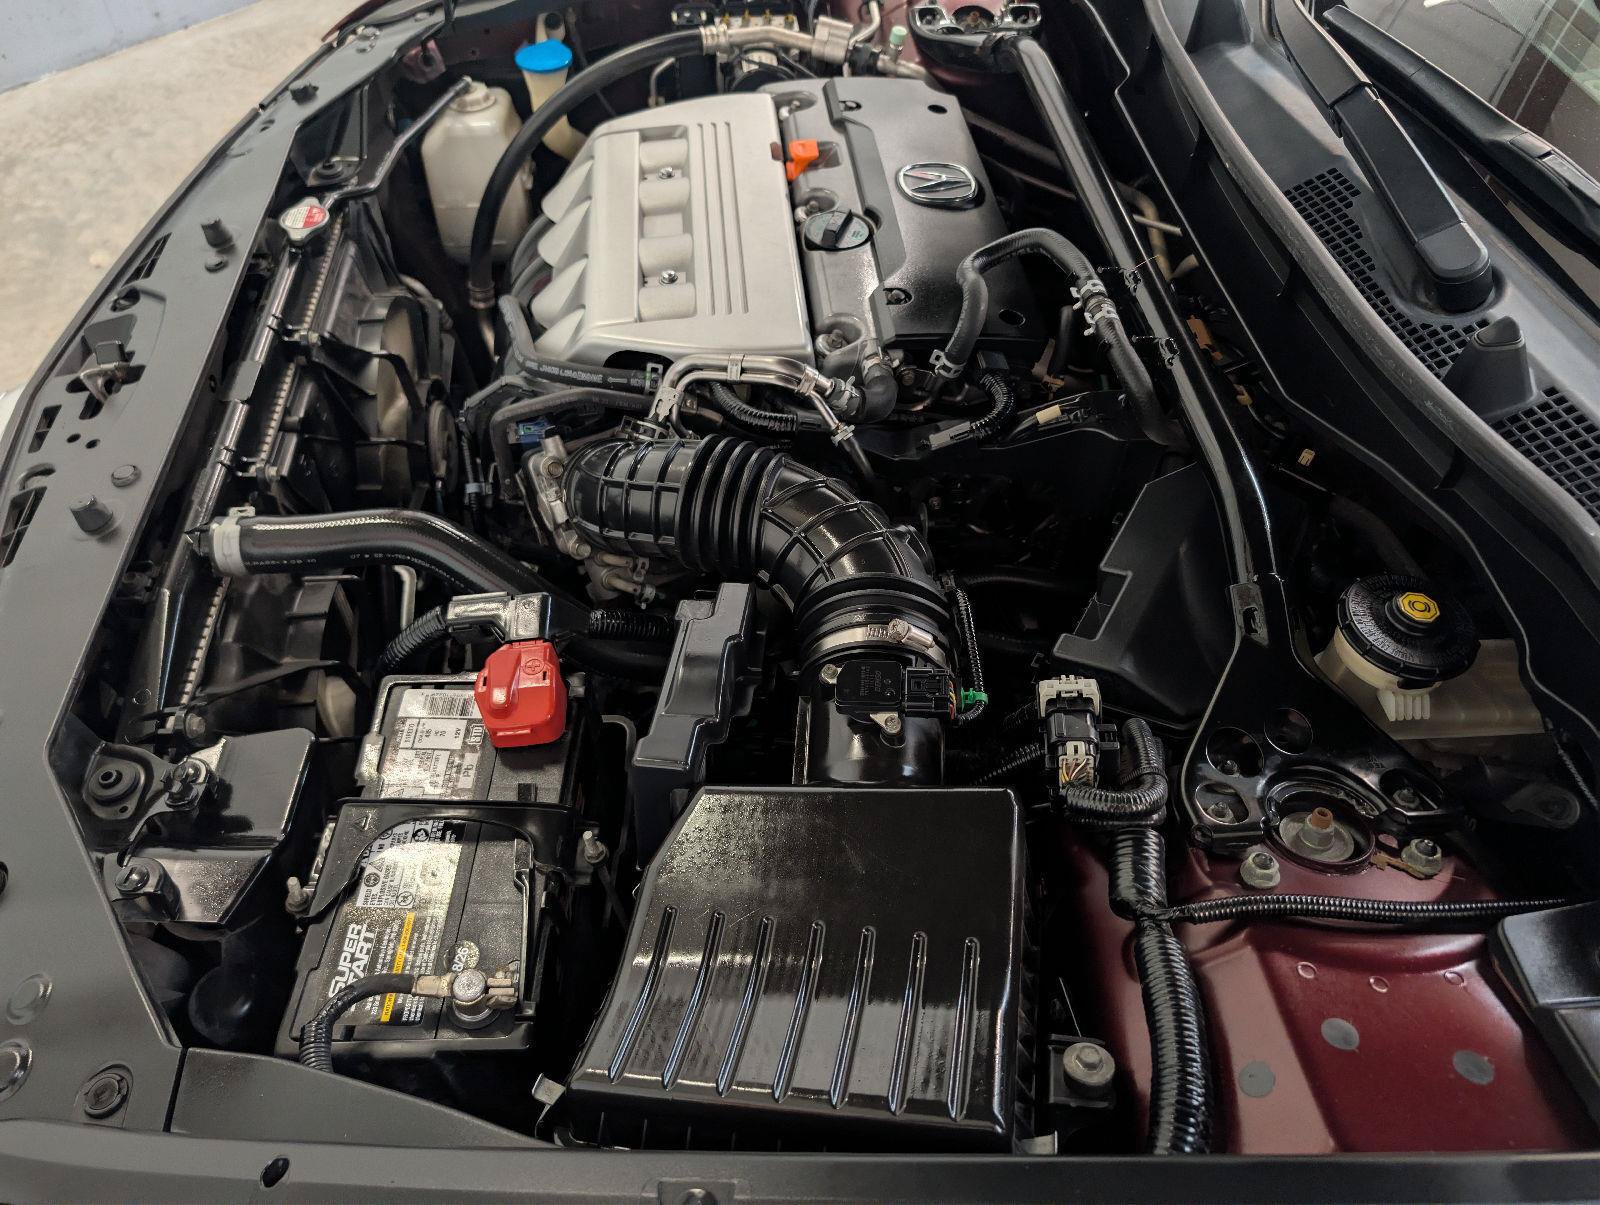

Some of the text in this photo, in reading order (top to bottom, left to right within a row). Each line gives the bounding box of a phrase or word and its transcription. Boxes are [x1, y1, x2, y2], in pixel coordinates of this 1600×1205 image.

[463, 764, 474, 777] Pb
[328, 923, 361, 998] SUPER
[344, 920, 377, 987] TART
[452, 947, 469, 972] 8/26
